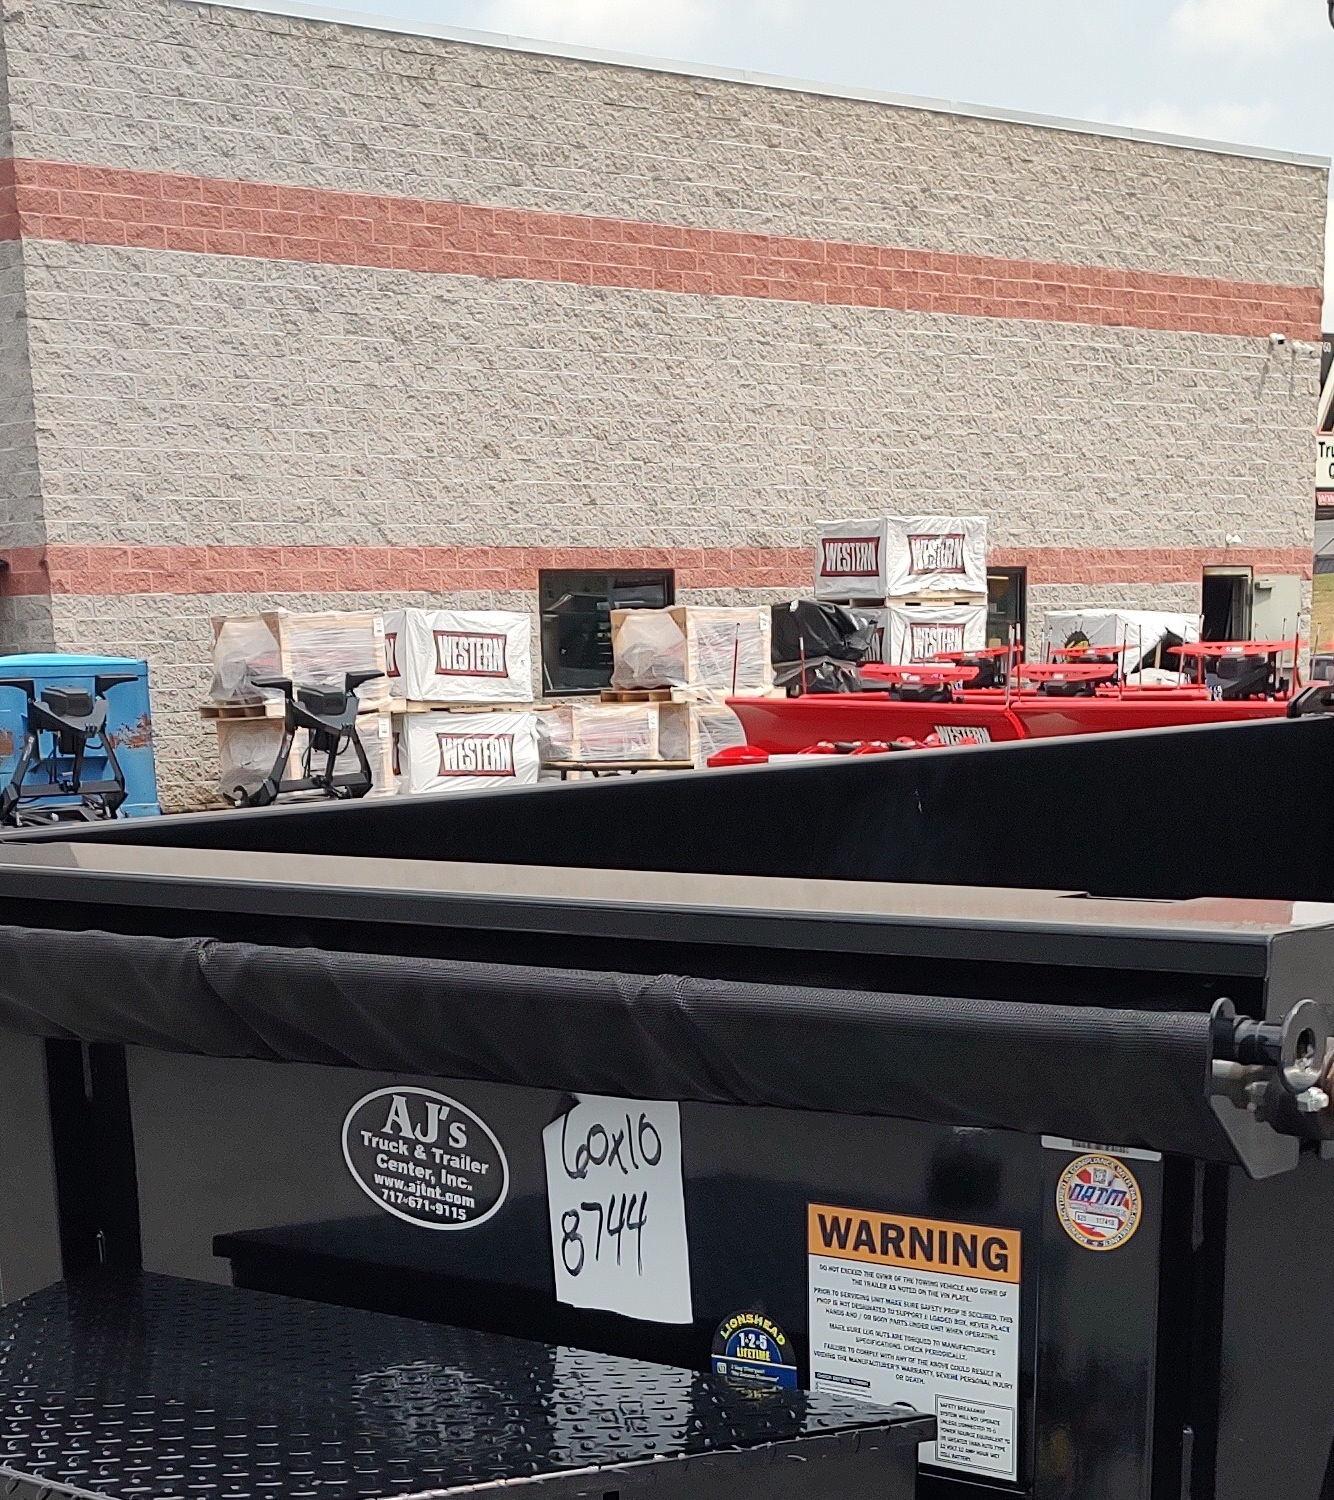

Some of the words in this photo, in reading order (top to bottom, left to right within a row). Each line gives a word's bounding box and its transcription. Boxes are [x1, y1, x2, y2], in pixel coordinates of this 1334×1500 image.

[825, 542, 876, 571] WESTERN
[912, 538, 963, 569] WESTERN
[438, 636, 504, 671] WESTERN
[915, 627, 963, 660] WESTERN
[442, 738, 511, 771] WESTERN
[381, 1094, 467, 1148] AJ's
[361, 1130, 409, 1156] Truck
[414, 1144, 427, 1160] &
[431, 1147, 489, 1175] Trailer
[376, 1153, 436, 1185] Center,
[441, 1168, 473, 1191] Inc.
[374, 1173, 475, 1208] www.ajtnt.com
[381, 1188, 467, 1221] 717-671-9115
[561, 1191, 648, 1277] 8744
[817, 1213, 1009, 1273] WARNING
[852, 1278, 862, 1286] THE
[864, 1280, 886, 1289] TRAILER
[898, 1285, 916, 1294] NOTED
[928, 1289, 938, 1297] THE
[720, 1313, 786, 1345] LIONSHEAD
[737, 1347, 771, 1362] LIFETIME
